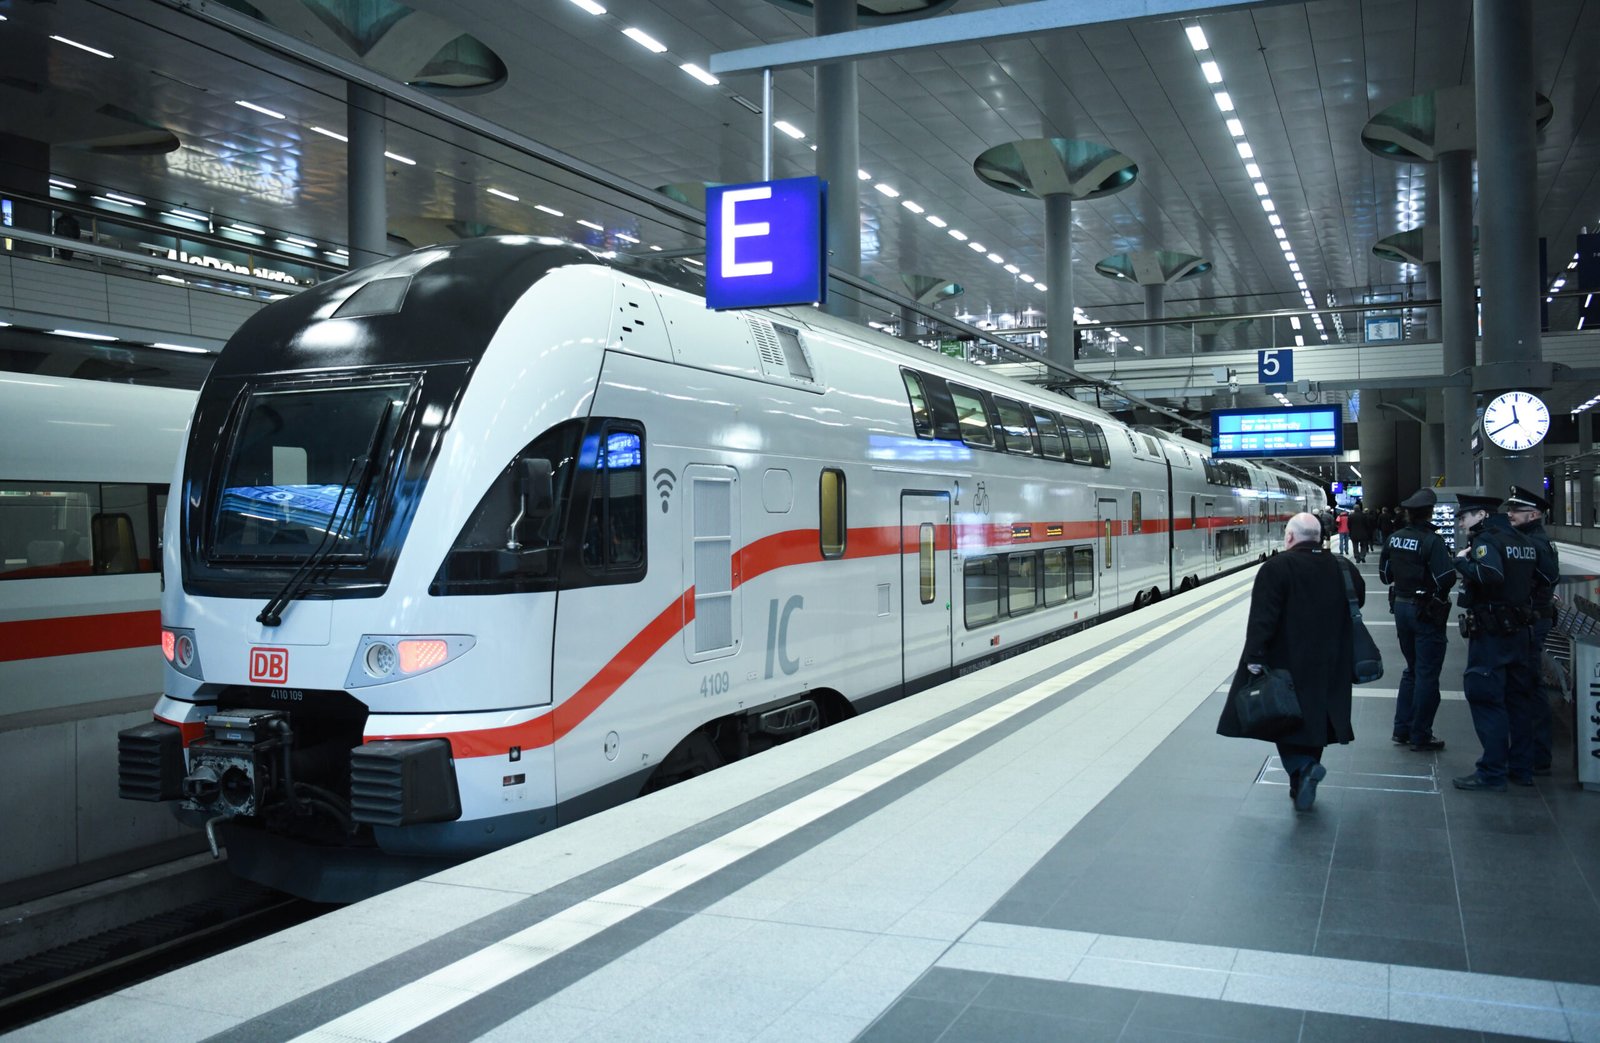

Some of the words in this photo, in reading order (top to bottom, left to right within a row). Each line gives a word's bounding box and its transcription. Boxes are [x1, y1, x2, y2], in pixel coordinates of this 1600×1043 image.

[721, 186, 773, 278] E
[1263, 351, 1280, 376] 5
[953, 480, 960, 506] 2
[1331, 482, 1339, 492] F
[1388, 536, 1418, 551] POLIZEI
[1505, 546, 1537, 560] POLIZEI
[764, 594, 804, 680] IC
[253, 652, 284, 679] DB
[271, 689, 288, 700] 4110
[289, 690, 303, 701] 109
[700, 671, 729, 698] 4109
